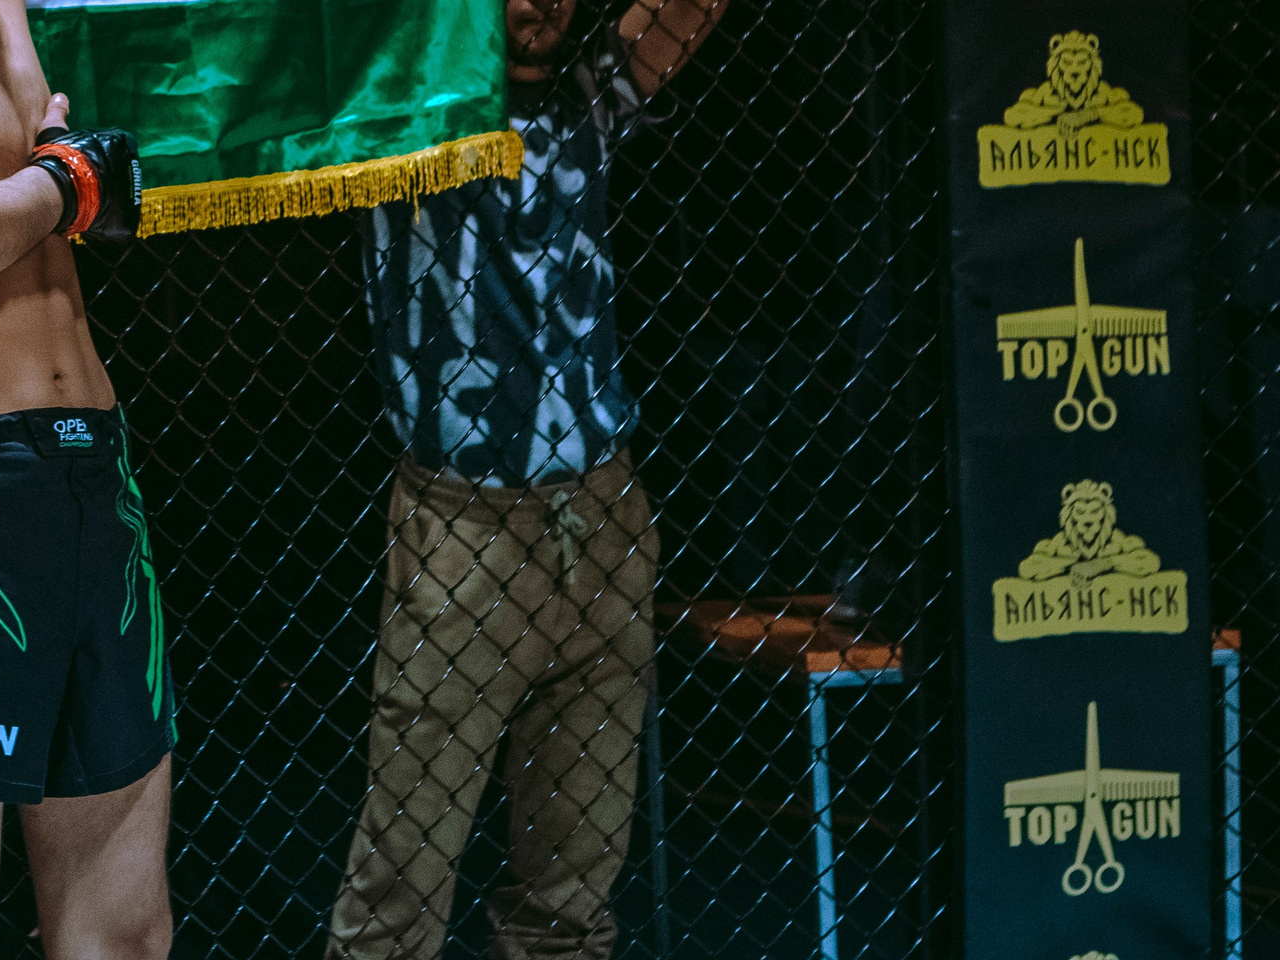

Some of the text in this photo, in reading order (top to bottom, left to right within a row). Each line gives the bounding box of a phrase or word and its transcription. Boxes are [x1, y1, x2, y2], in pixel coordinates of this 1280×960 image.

[997, 337, 1171, 381] TOP GUN
[1004, 797, 1181, 848] TOP GUN
